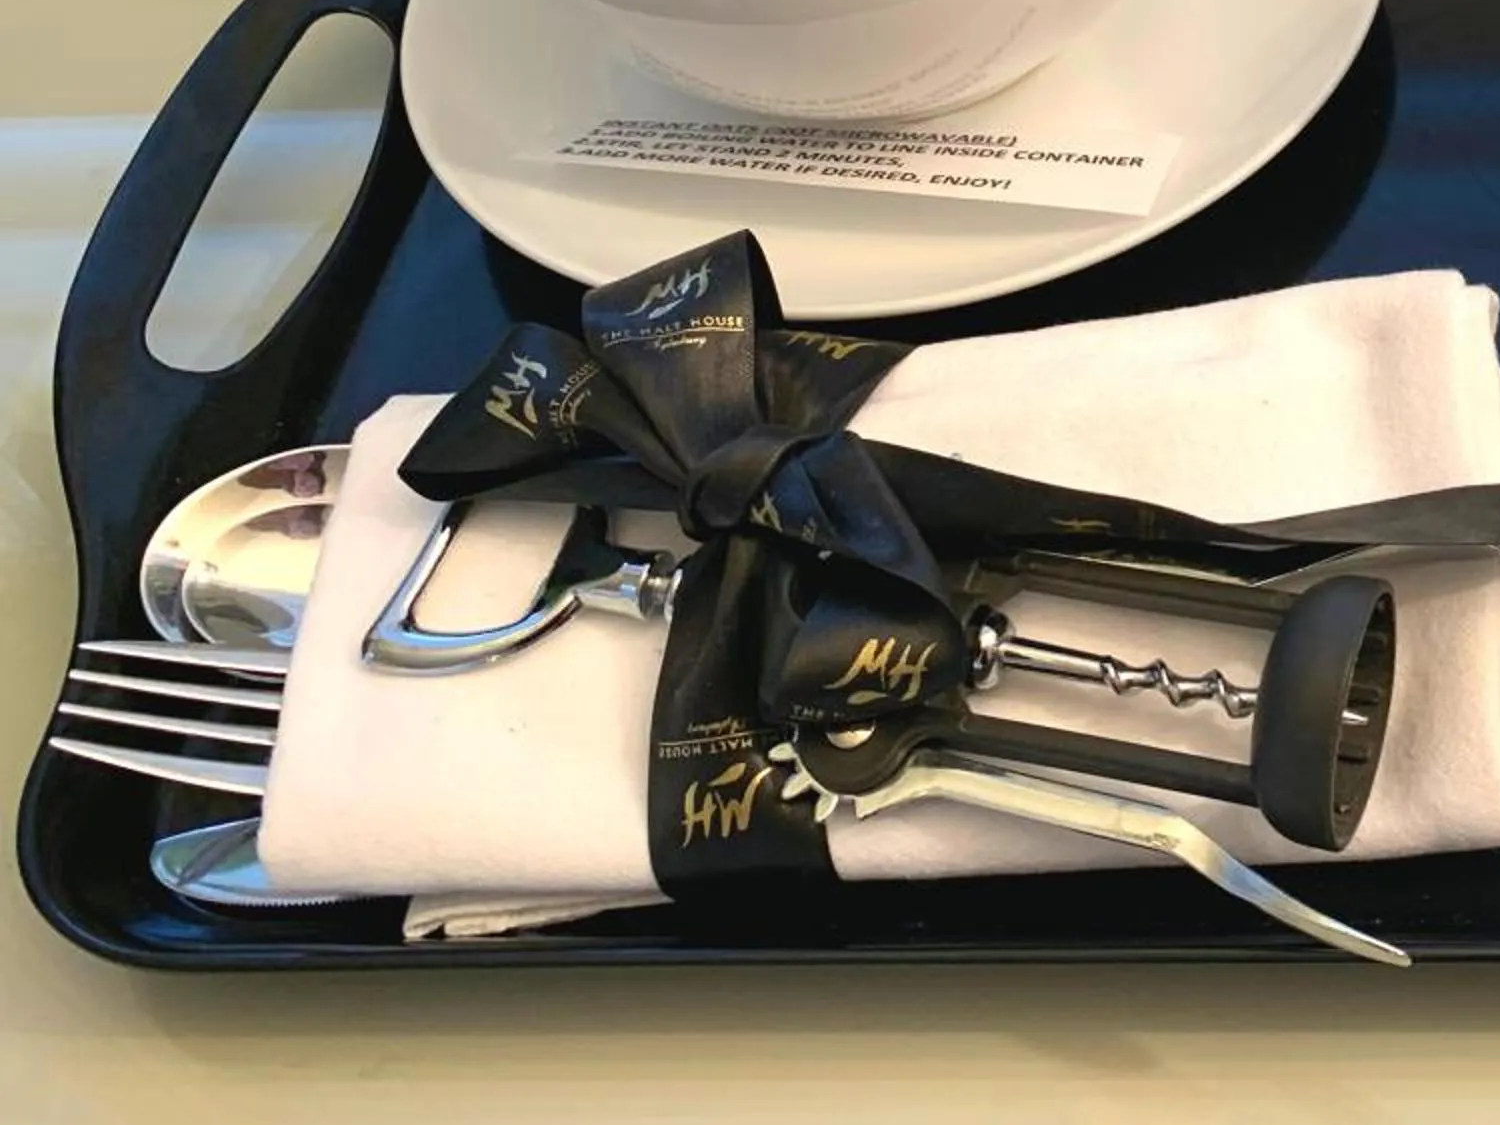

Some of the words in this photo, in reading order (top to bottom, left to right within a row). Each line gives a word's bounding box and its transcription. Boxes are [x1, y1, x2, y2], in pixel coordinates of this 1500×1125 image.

[652, 141, 695, 151] LET
[696, 144, 773, 157] STAND
[776, 149, 792, 158] 2
[795, 151, 905, 168] MINUTES,
[661, 131, 754, 144] BOILING
[759, 136, 840, 149] WATER
[846, 141, 876, 151] TO
[879, 143, 931, 154] LINE
[933, 145, 1009, 158] INSIDE
[1013, 149, 1146, 168] CONTAINER
[632, 151, 705, 165] MORE
[709, 158, 792, 172] WATER
[794, 163, 820, 174] IF
[820, 166, 921, 184] DESIRED,
[928, 174, 1013, 190] ENJOY!
[690, 315, 744, 328] HOUSE
